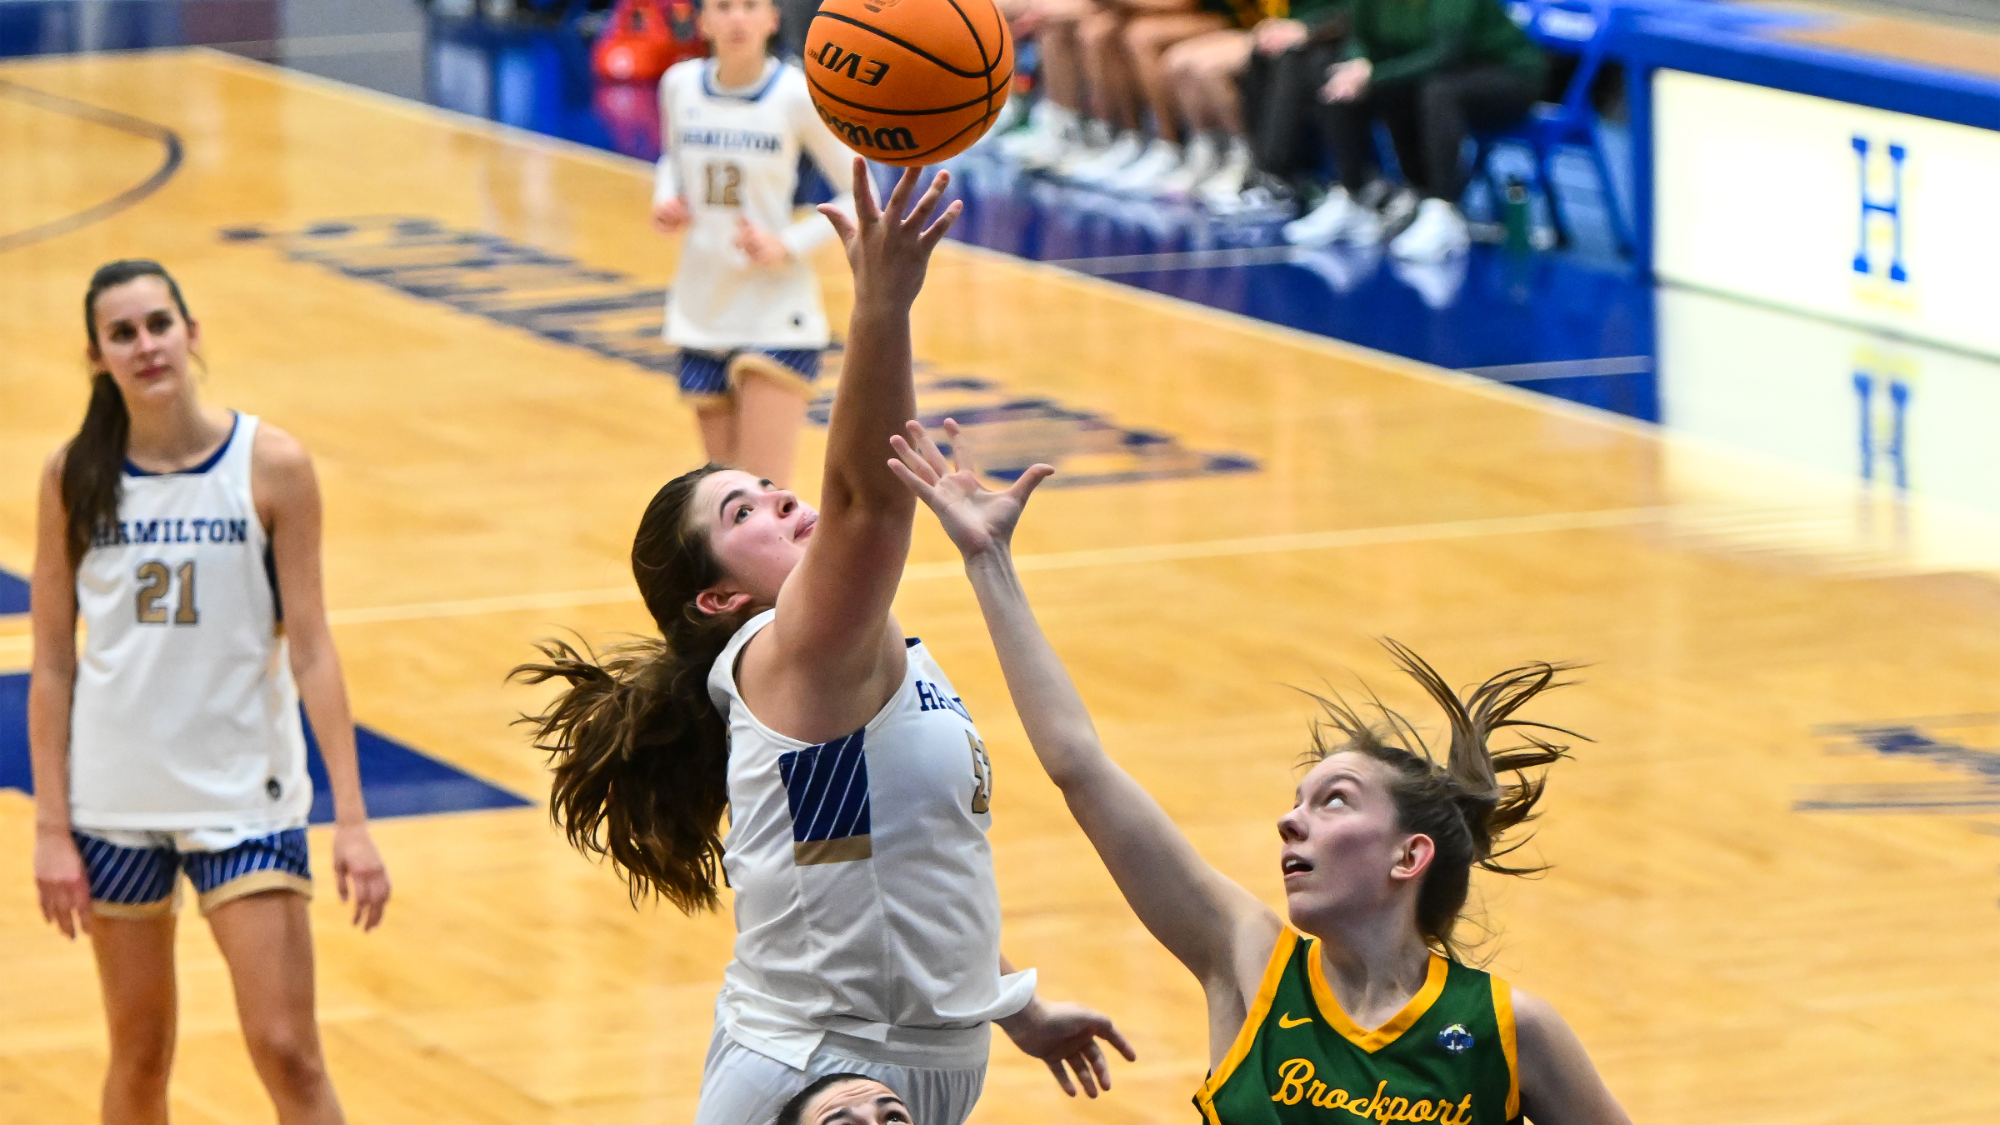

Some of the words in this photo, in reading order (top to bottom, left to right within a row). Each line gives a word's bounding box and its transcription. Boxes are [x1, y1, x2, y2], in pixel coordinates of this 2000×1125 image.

[817, 41, 890, 87] EVO
[704, 163, 742, 206] 12
[1851, 137, 1907, 282] H
[135, 560, 199, 625] 21
[1271, 1057, 1474, 1125] Brockport
